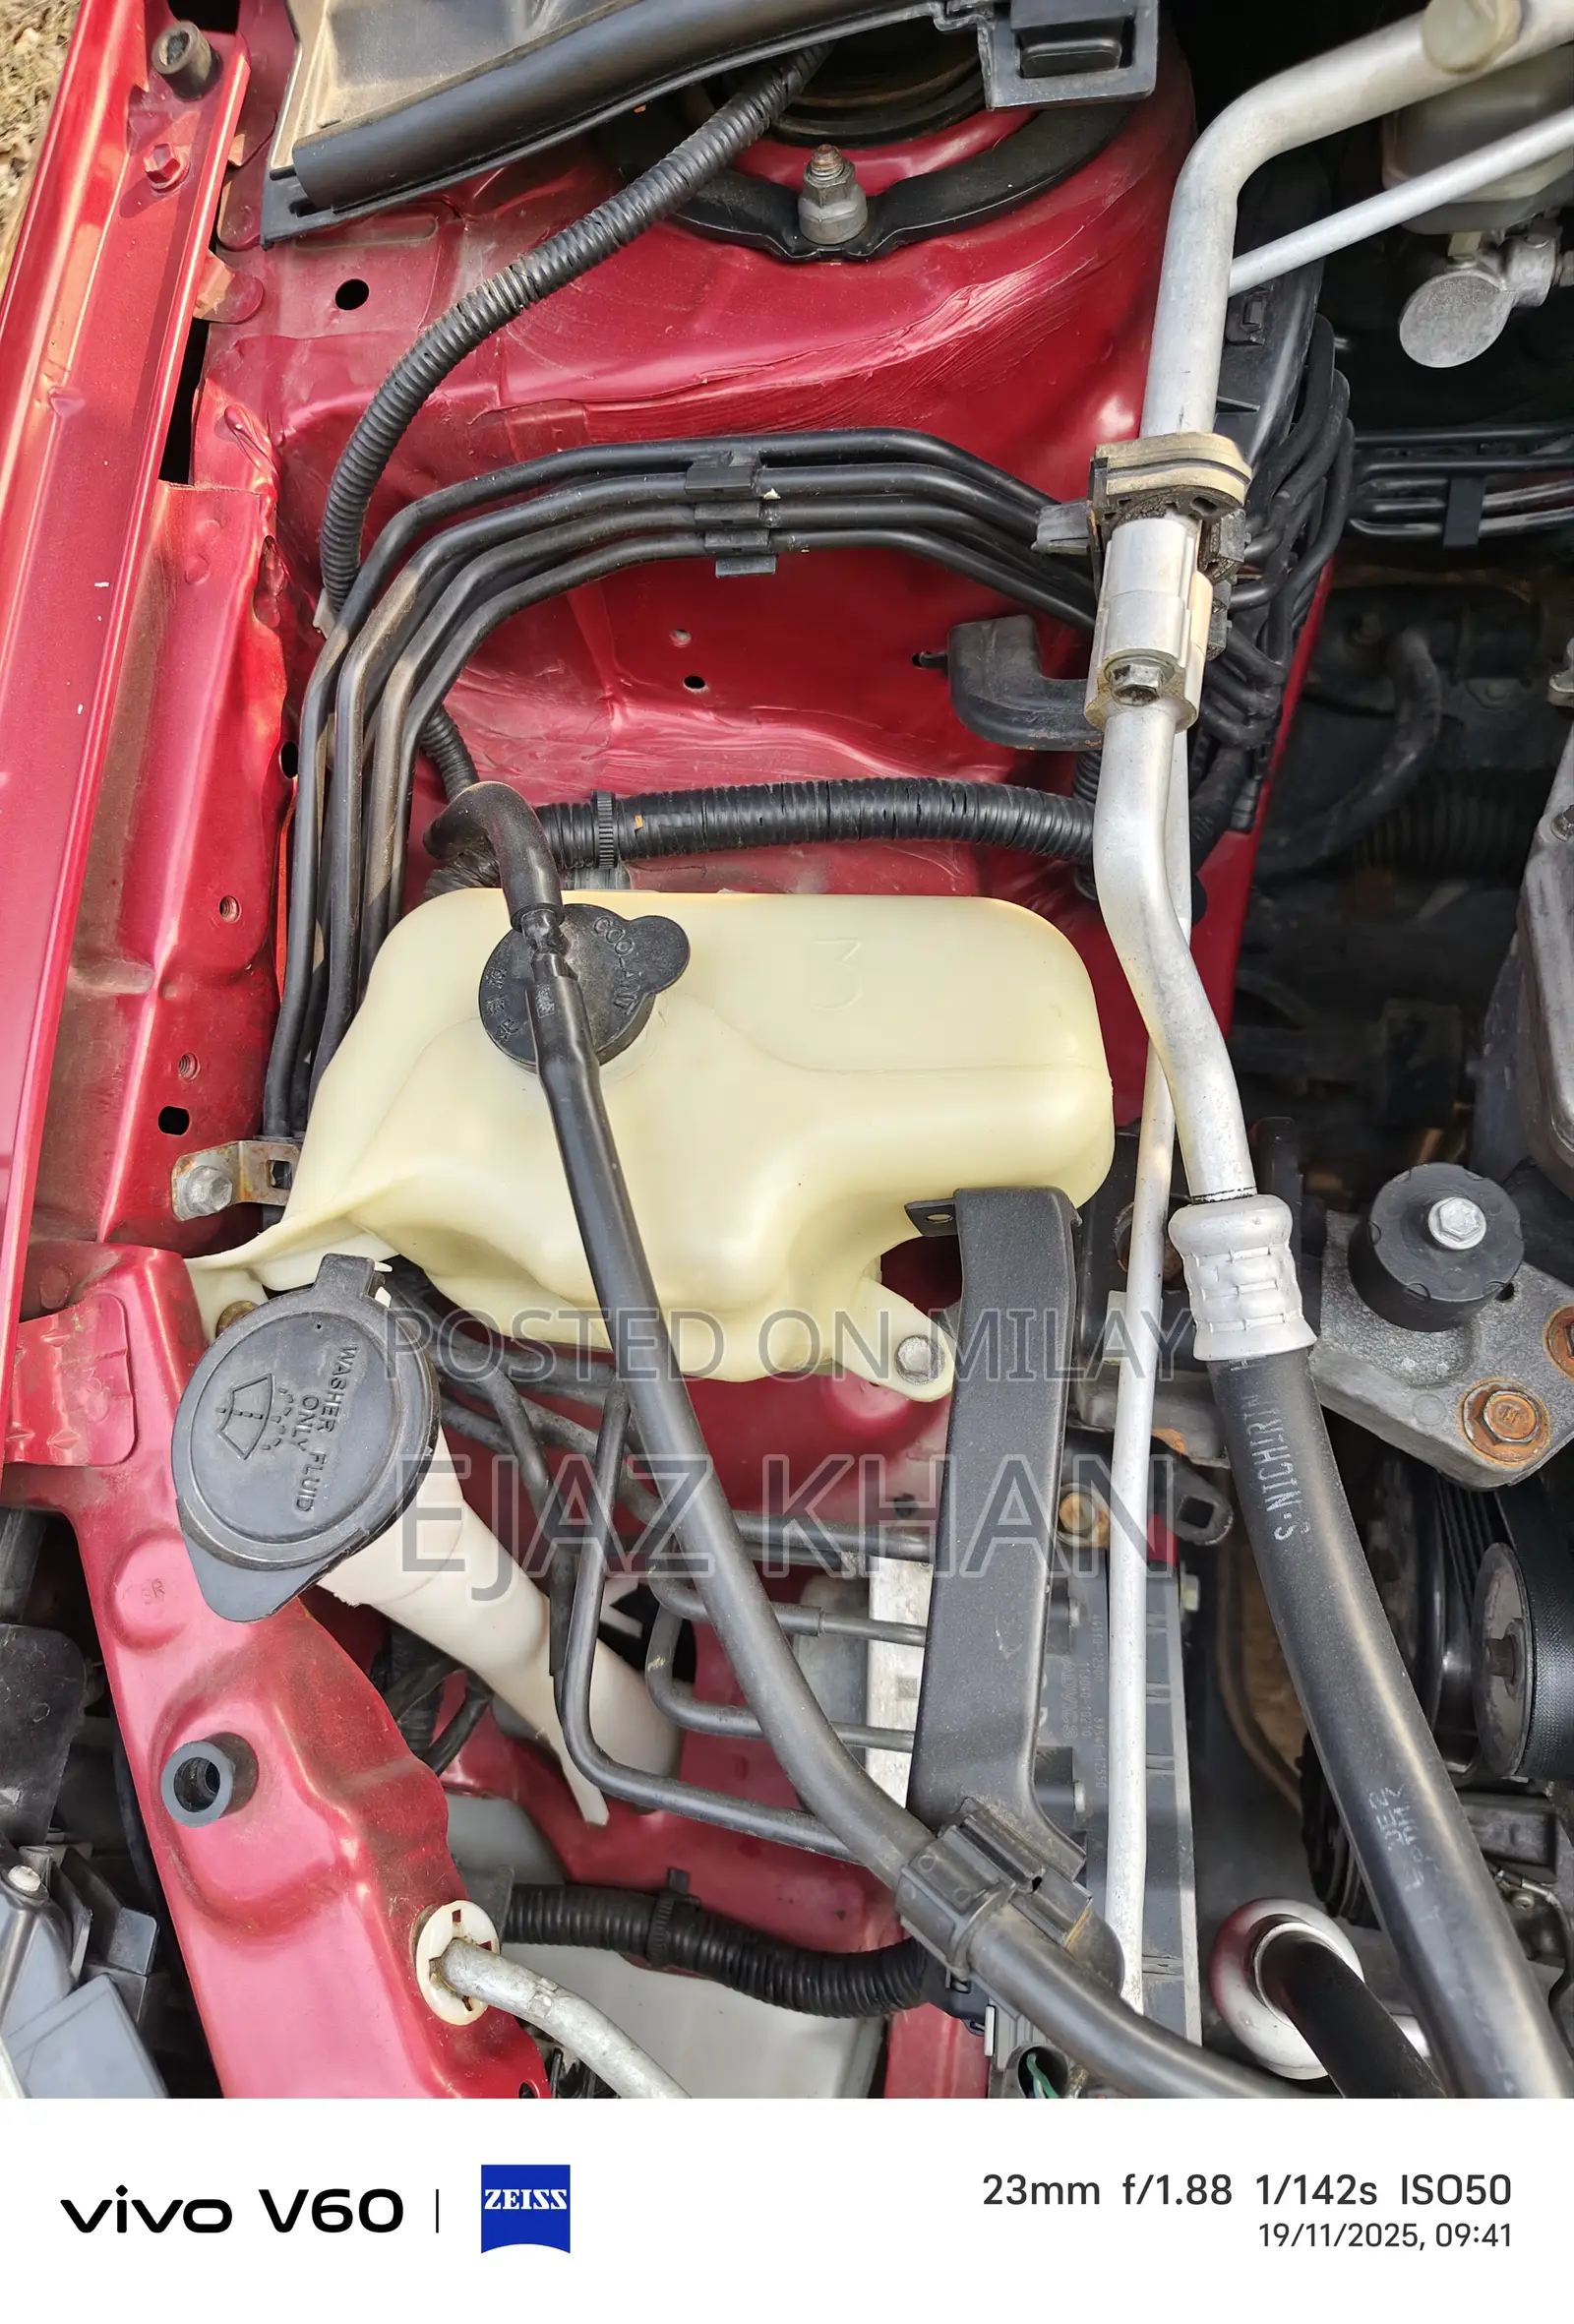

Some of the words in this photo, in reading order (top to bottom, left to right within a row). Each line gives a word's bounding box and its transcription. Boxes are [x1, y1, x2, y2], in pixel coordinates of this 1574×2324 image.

[291, 1394, 320, 1452] ONLY
[317, 1346, 357, 1433] WASHER
[296, 1451, 327, 1513] FLUID
[1059, 1657, 1079, 1740] ADVICS
